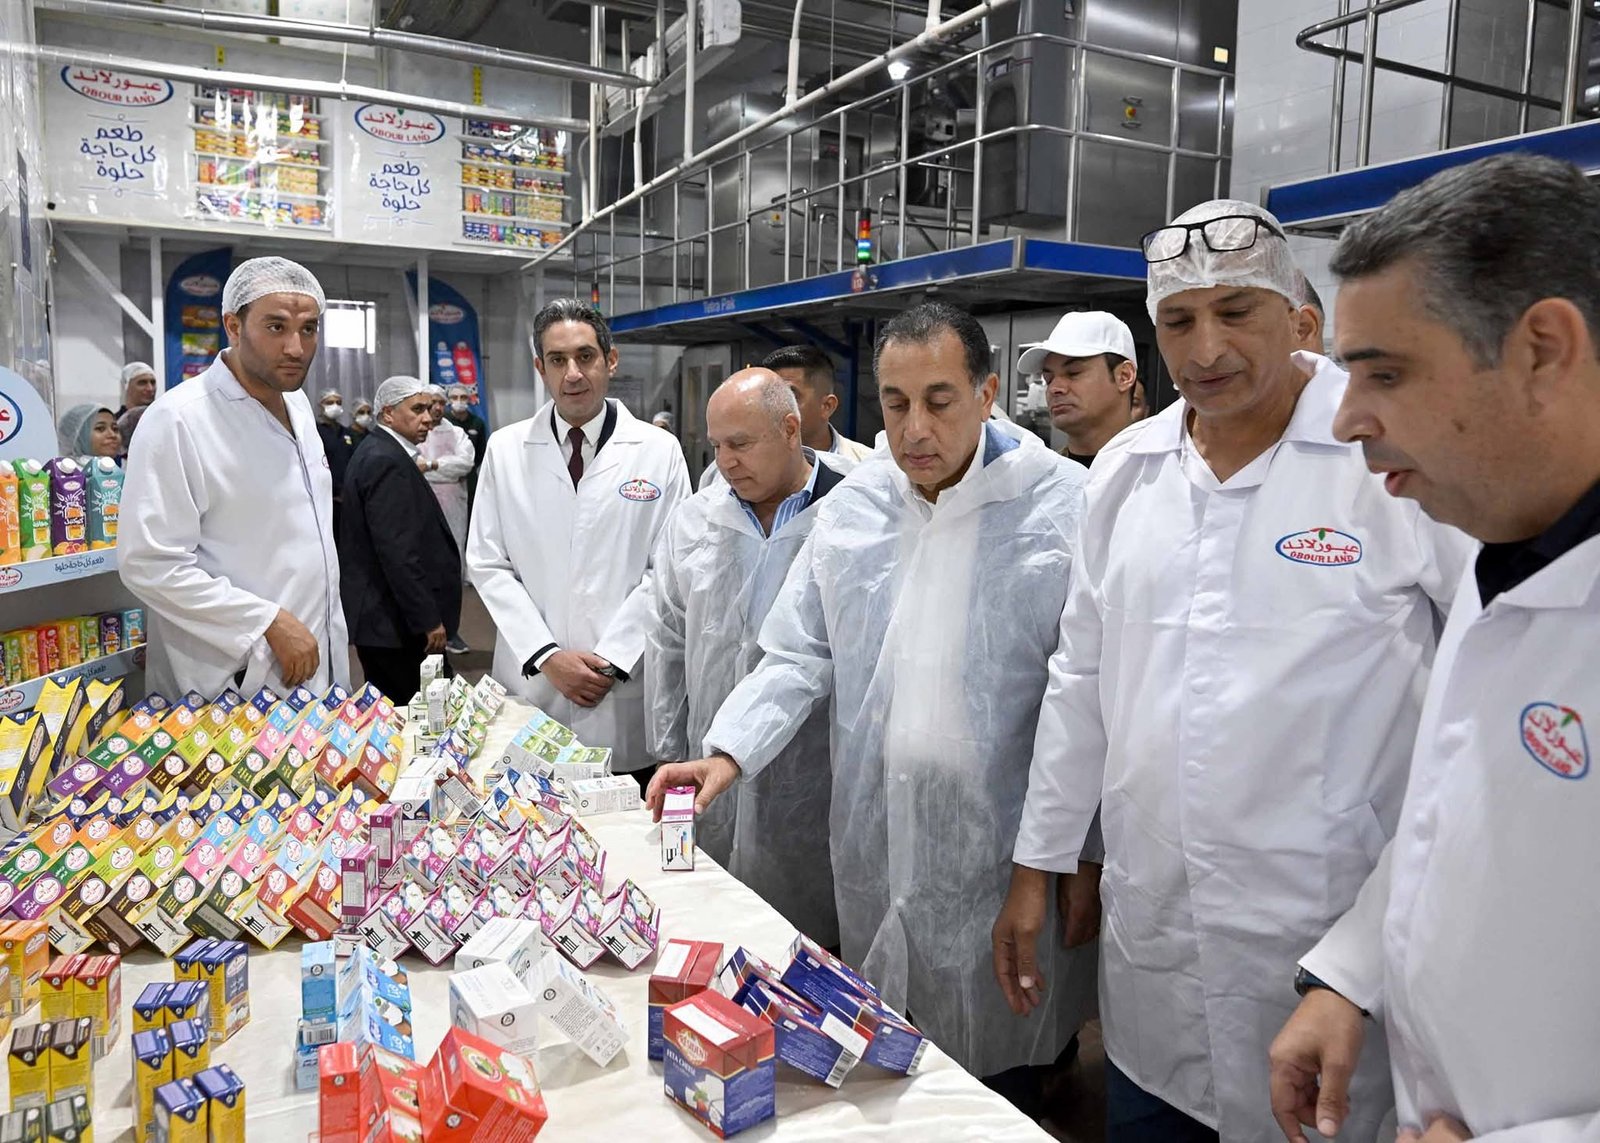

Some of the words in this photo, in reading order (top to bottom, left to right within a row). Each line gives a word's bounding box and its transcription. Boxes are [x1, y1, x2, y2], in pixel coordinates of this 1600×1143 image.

[81, 85, 122, 102] OBOUR
[126, 95, 155, 104] LAND
[95, 124, 143, 142] طعم
[370, 126, 404, 141] OBOUR
[406, 134, 431, 142] LAND
[81, 138, 129, 158] حاجة
[132, 145, 156, 165] كل
[97, 161, 144, 182] حلوة
[382, 160, 420, 176] طعم
[369, 173, 408, 191] حاجة
[410, 179, 431, 197] كل
[382, 193, 421, 213] حلوة
[1290, 551, 1325, 563] OBOUR
[1327, 554, 1354, 563] LAND
